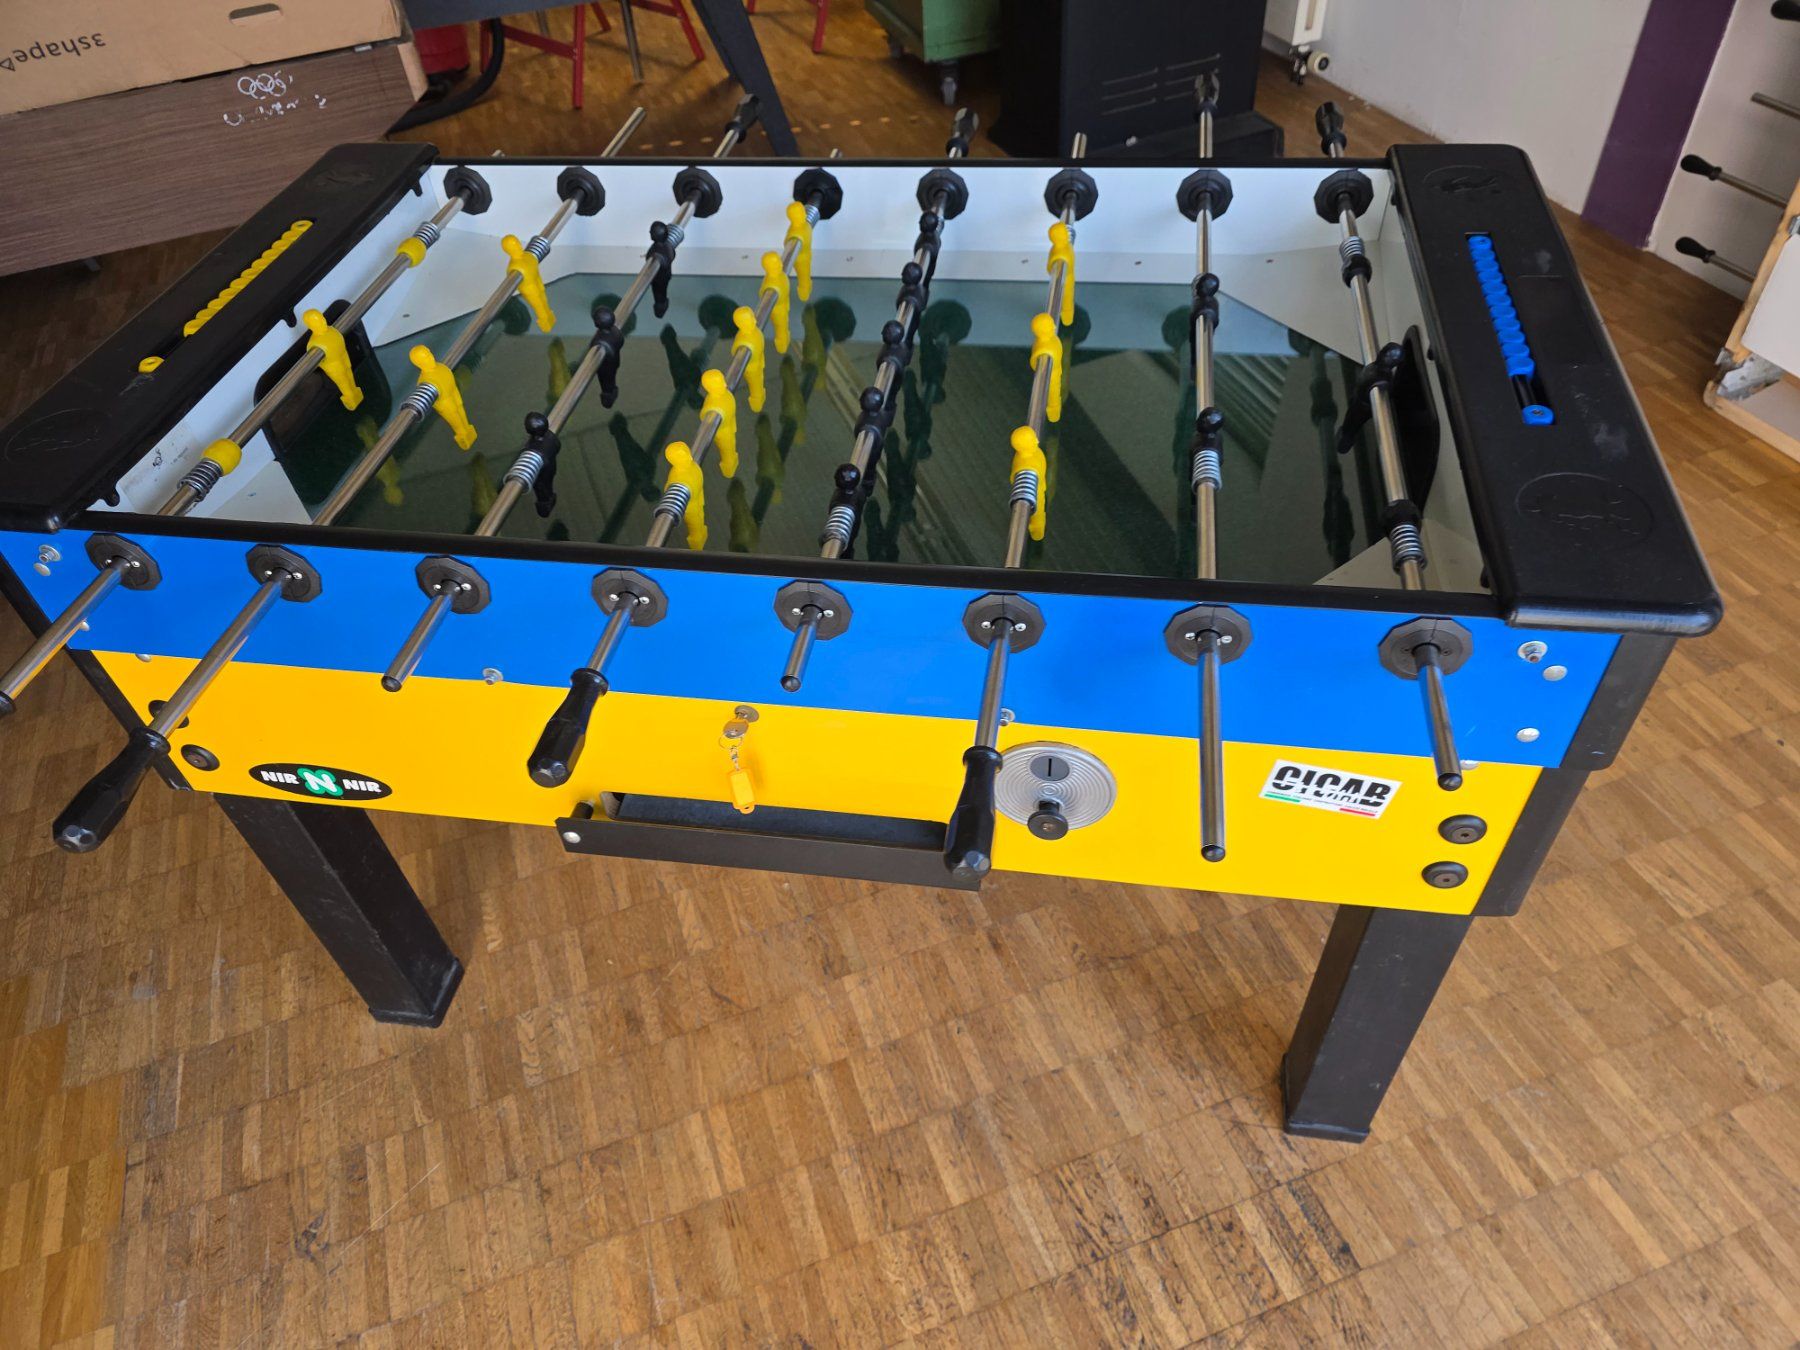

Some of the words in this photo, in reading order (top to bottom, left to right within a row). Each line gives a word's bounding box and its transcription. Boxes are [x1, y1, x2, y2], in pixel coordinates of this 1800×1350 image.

[12, 33, 106, 62] 3shape
[260, 770, 299, 785] NIR
[343, 778, 382, 793] NIR
